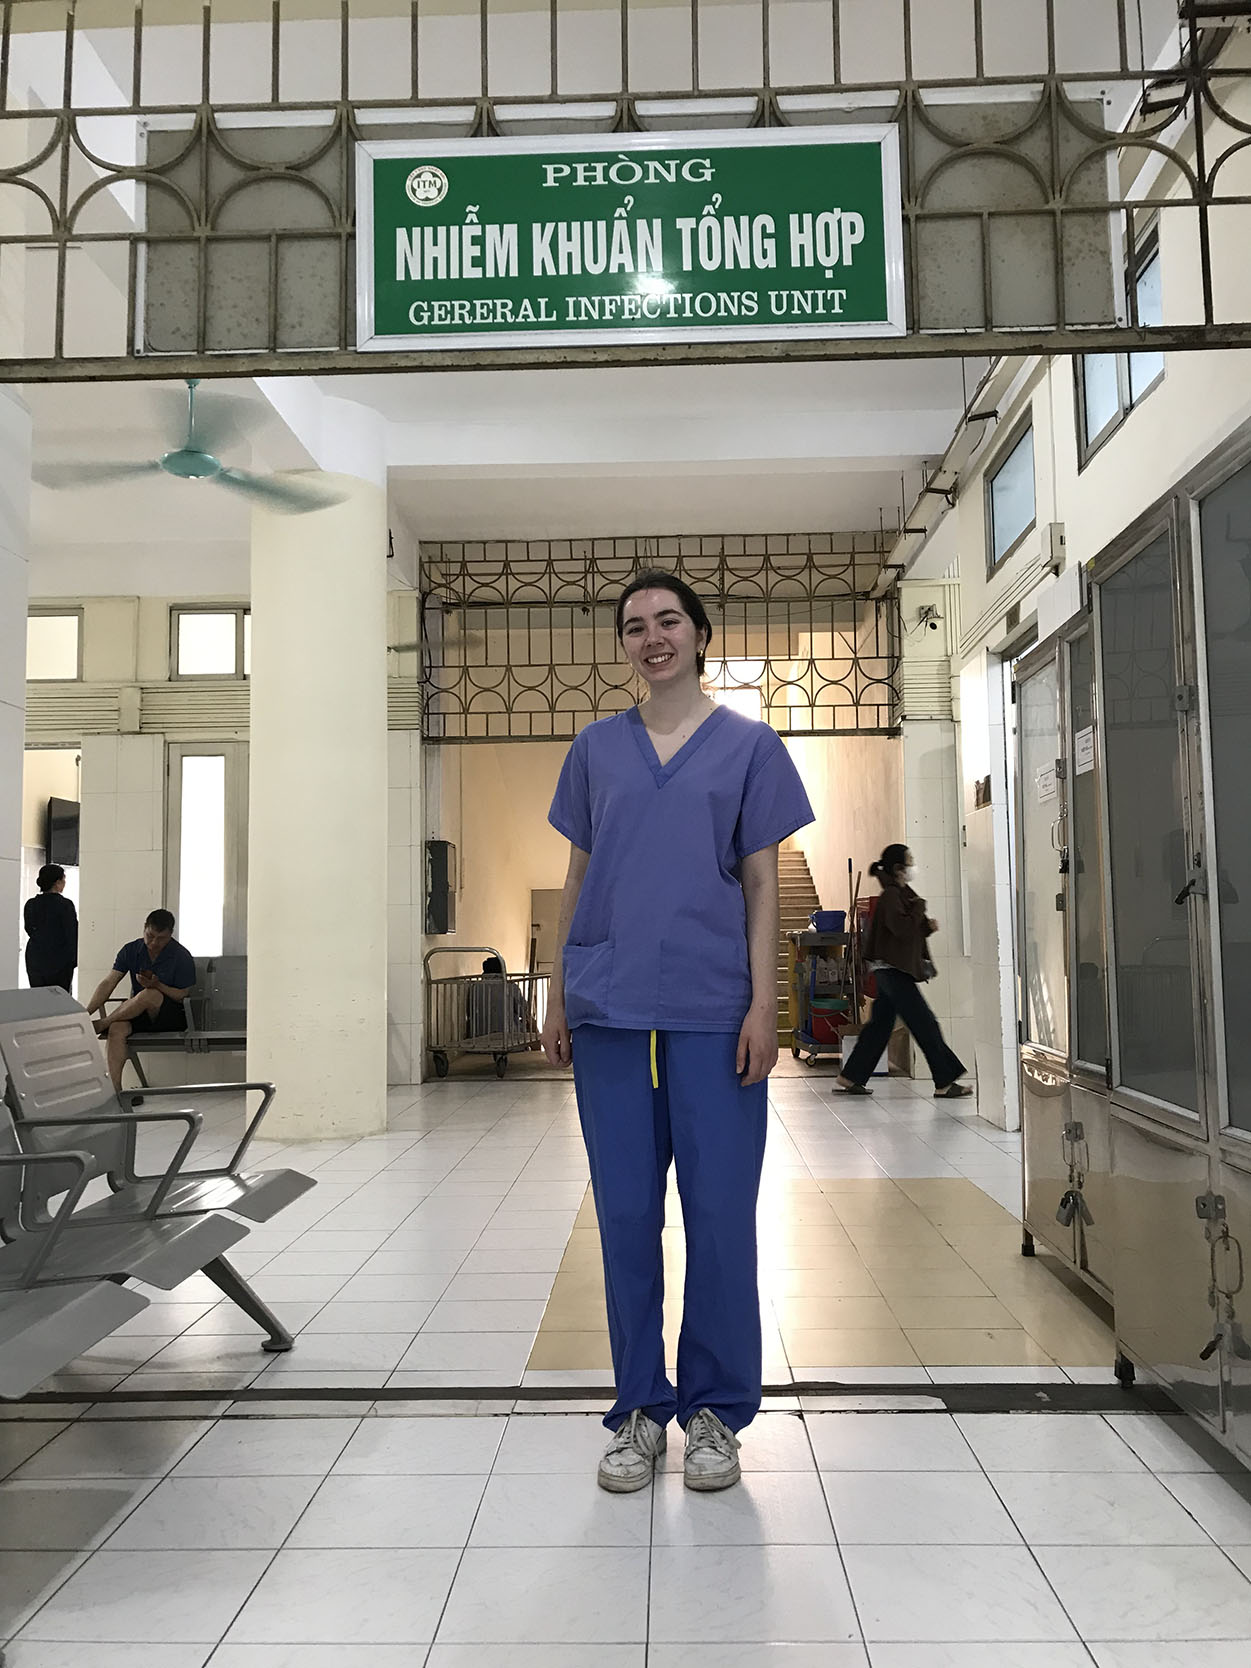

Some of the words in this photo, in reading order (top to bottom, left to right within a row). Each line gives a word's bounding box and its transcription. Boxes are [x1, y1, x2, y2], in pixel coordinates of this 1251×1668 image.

[417, 179, 437, 189] ITM
[542, 154, 716, 187] PHÒNG
[395, 204, 519, 281] NHIỄM
[533, 195, 663, 277] KHUẨN
[676, 192, 777, 272] TỔNG
[790, 207, 865, 279] HỢP
[408, 297, 557, 326] GERERAL
[565, 291, 759, 324] INFECTIONS
[767, 289, 847, 316] UNIT
